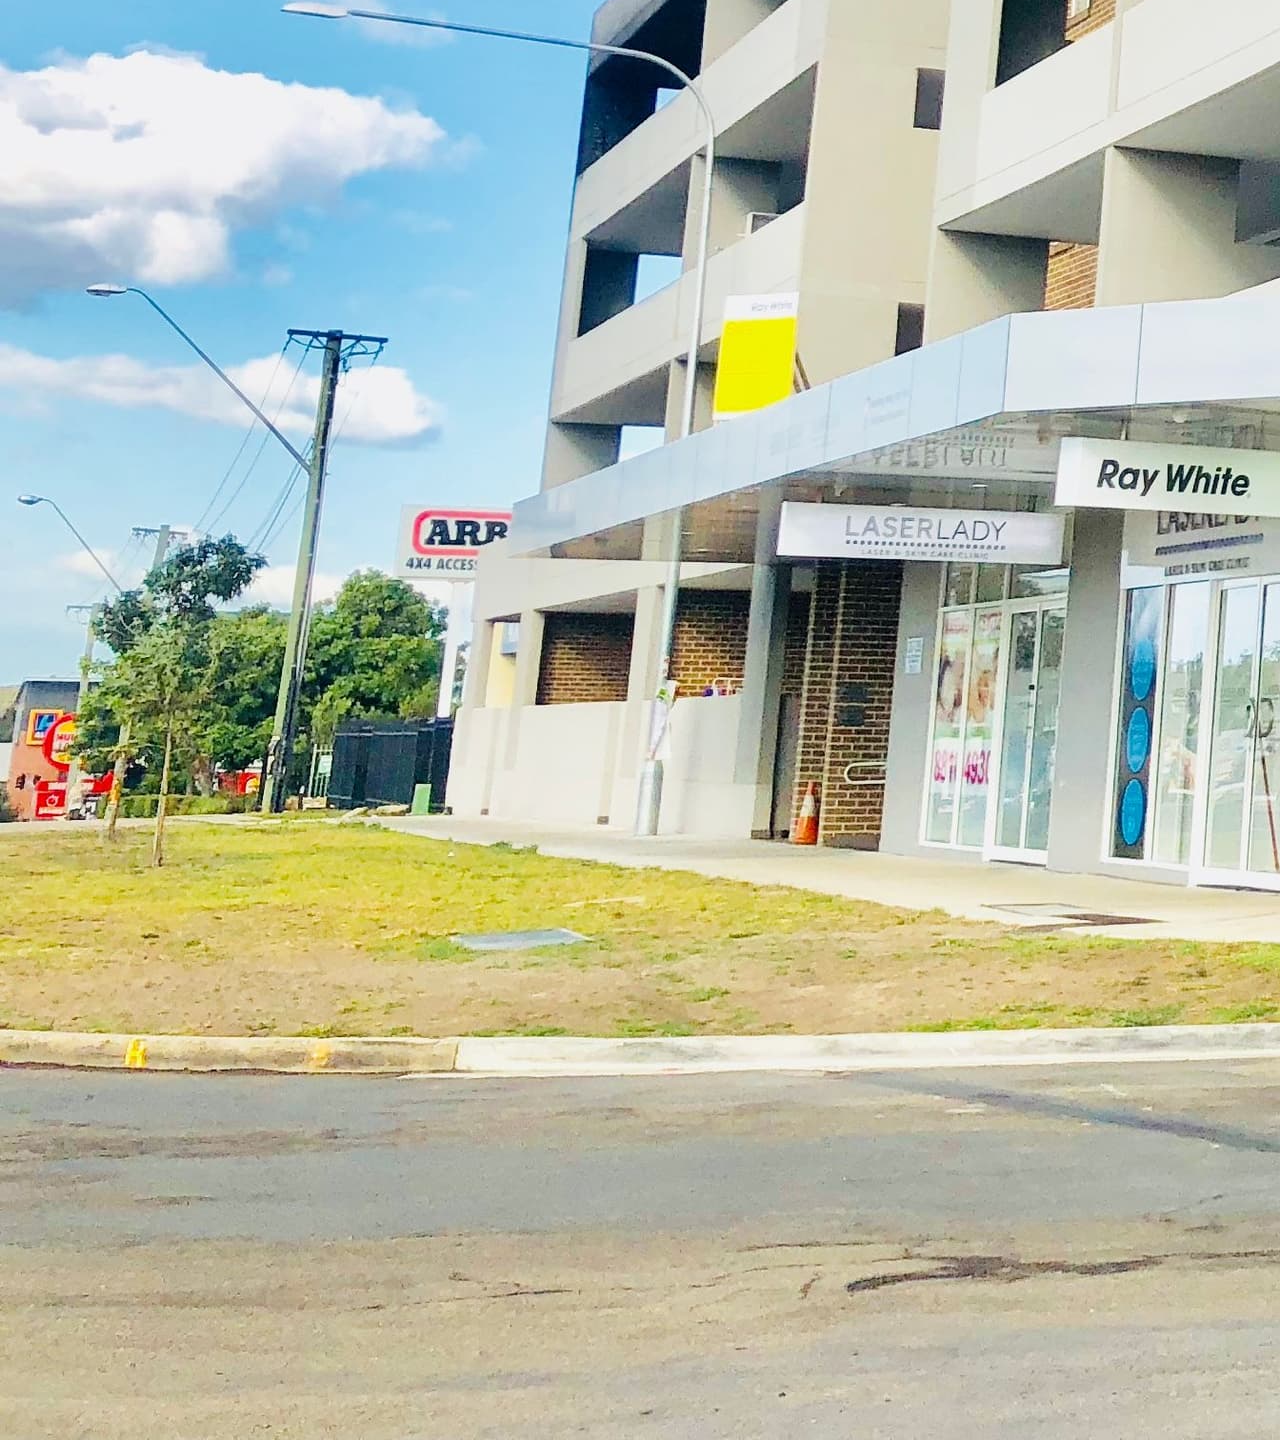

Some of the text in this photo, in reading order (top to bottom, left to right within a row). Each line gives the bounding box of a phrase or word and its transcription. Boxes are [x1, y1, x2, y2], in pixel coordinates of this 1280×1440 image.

[1097, 459, 1250, 496] Ray White
[845, 515, 1007, 541] LASERLADY
[436, 558, 478, 571] ACCES
